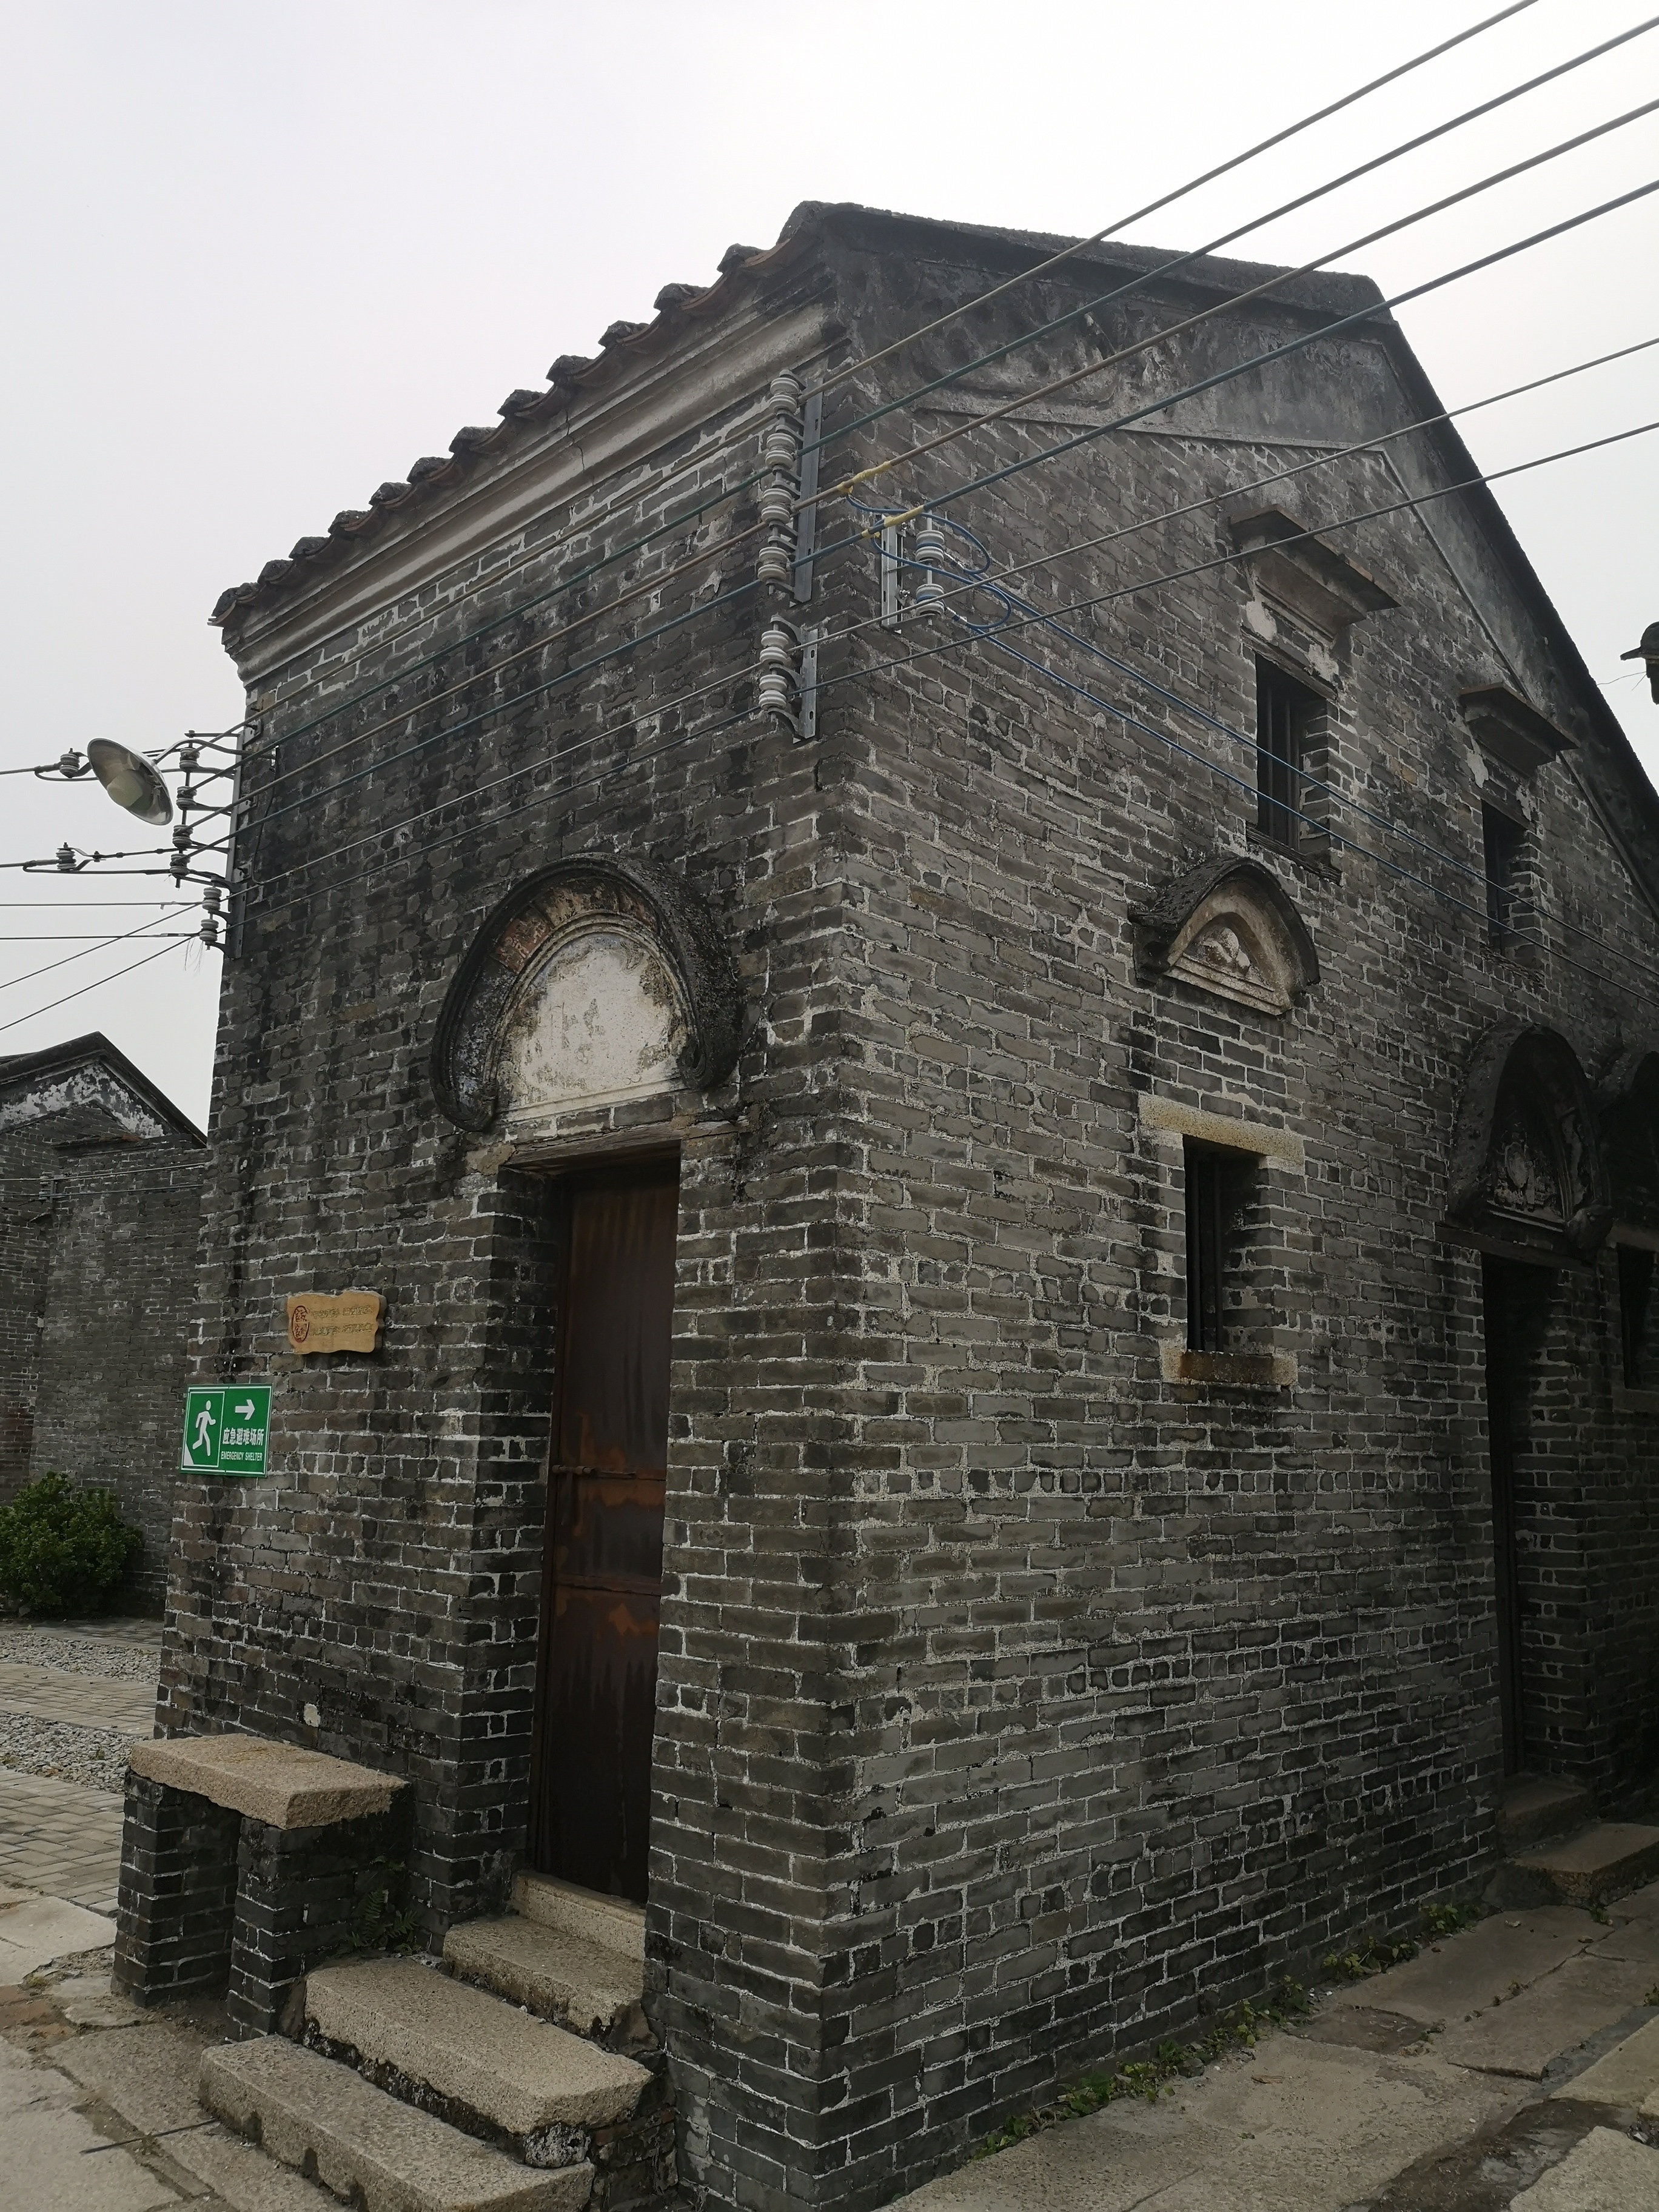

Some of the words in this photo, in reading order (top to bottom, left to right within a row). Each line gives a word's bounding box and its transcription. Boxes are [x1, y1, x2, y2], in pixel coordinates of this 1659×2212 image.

[223, 1427, 264, 1446] 应急避难场所
[221, 1451, 244, 1460] EMERGENCY
[245, 1452, 263, 1461] SHELTER
